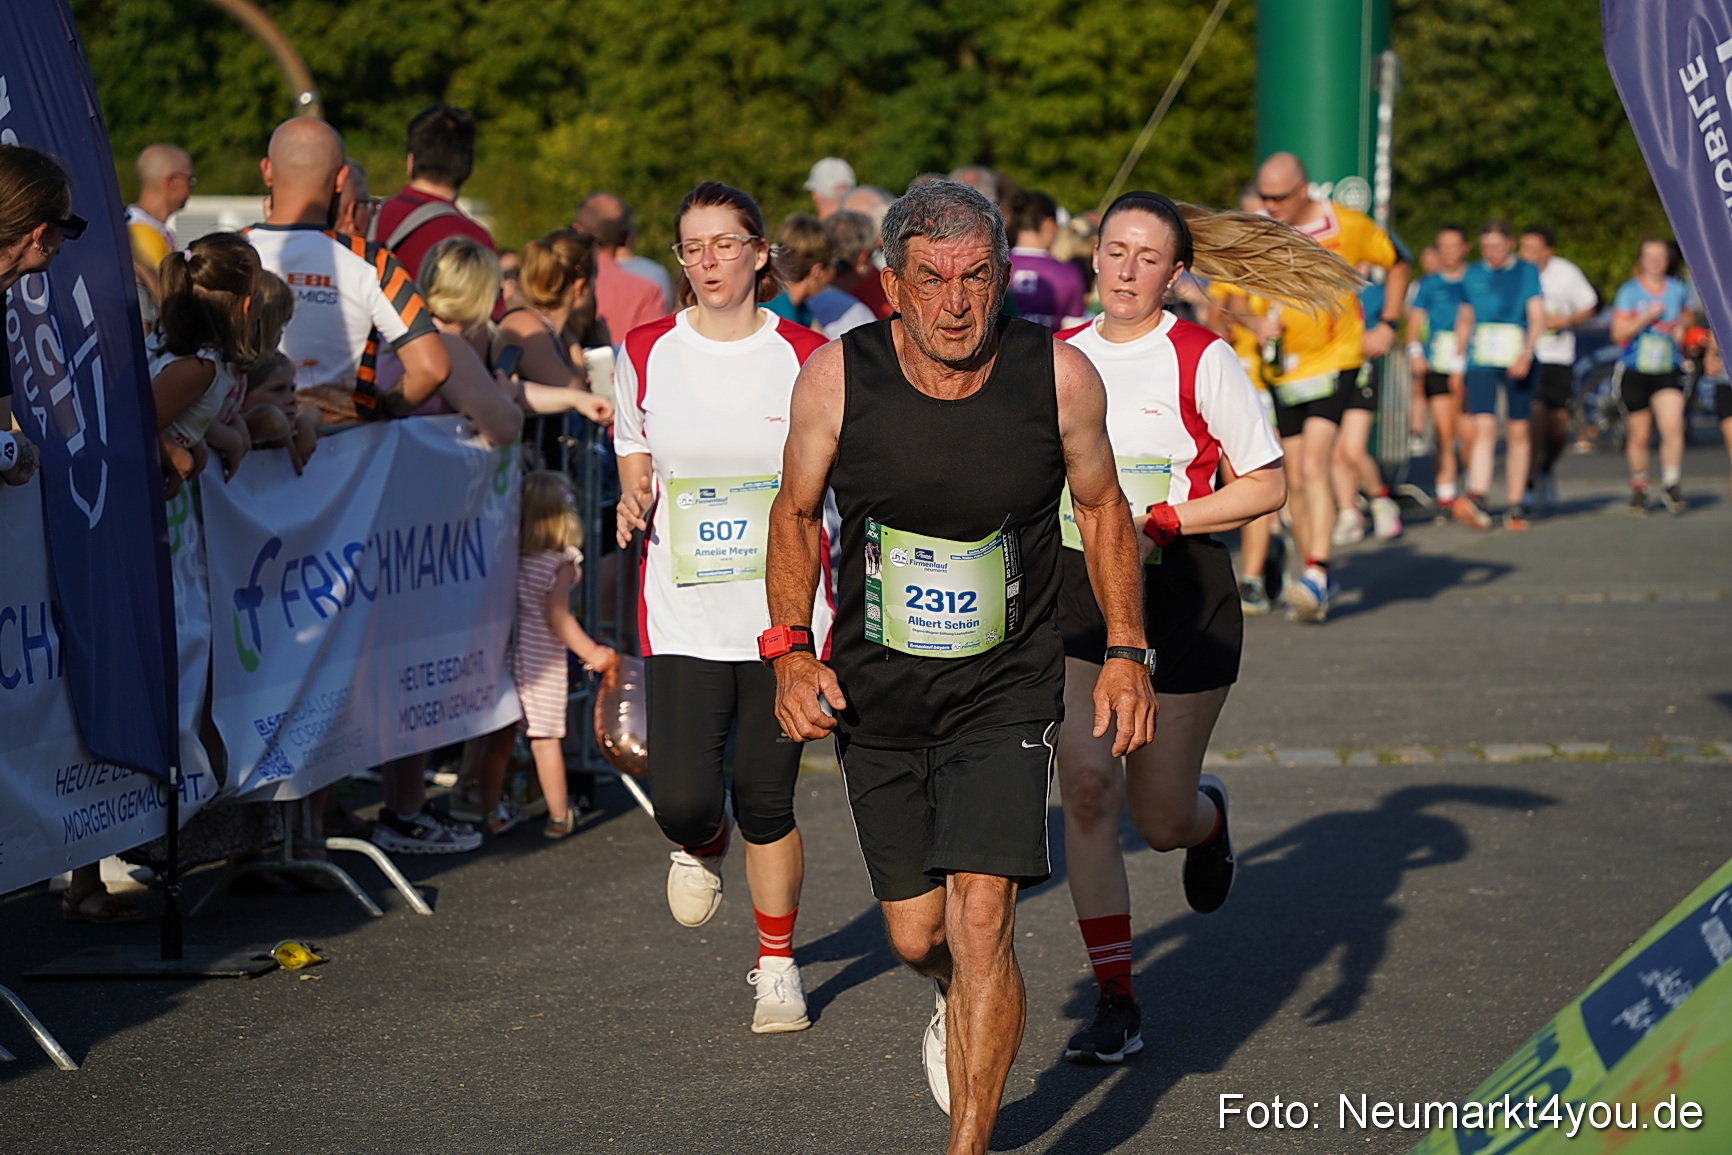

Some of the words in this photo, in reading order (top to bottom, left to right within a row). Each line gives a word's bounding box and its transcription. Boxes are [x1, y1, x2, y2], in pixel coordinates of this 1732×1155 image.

[699, 520, 748, 541] 607
[695, 548, 727, 556] Amelie
[729, 547, 758, 556] Meyer
[1002, 534, 1010, 562] RABATT
[281, 516, 487, 628] FRISCHMANN
[909, 559, 948, 569] Firmenlauf
[905, 585, 978, 614] 2312
[908, 615, 941, 629] Albert
[944, 618, 980, 630] Schön
[1008, 598, 1016, 631] HILTL
[400, 700, 446, 734] MORGEN
[55, 762, 109, 798] HEUTE
[62, 796, 116, 845] MORGEN
